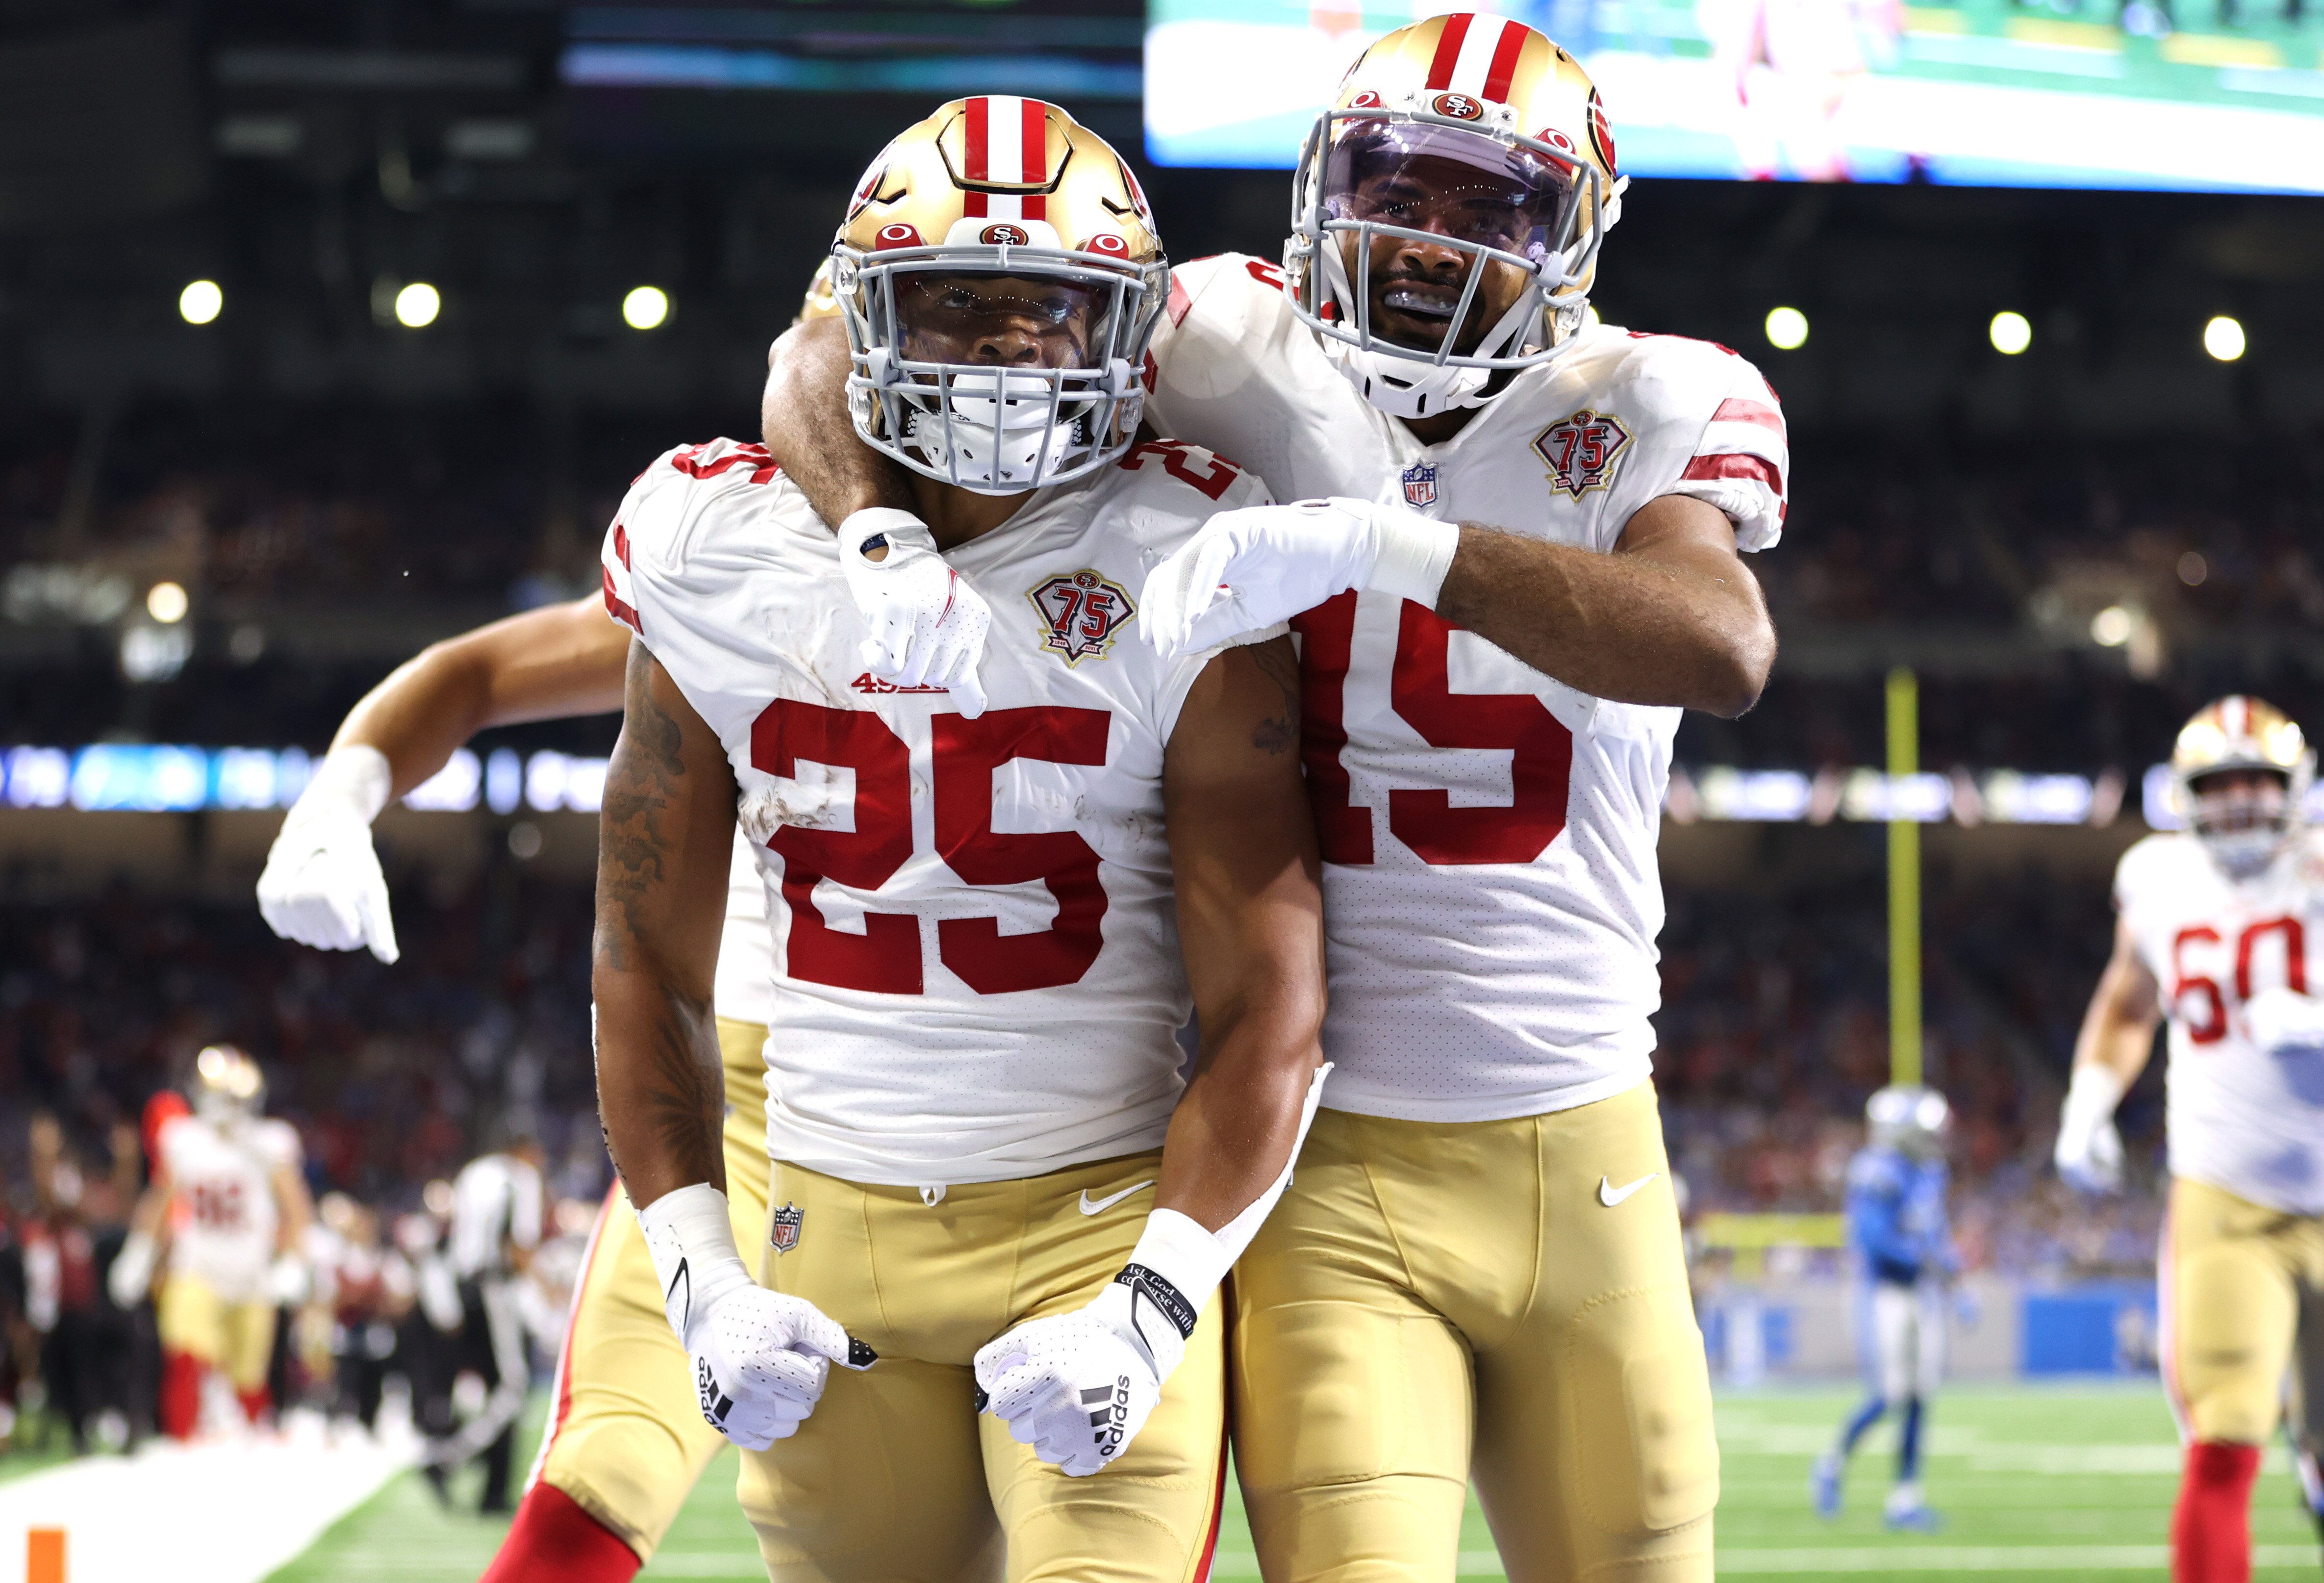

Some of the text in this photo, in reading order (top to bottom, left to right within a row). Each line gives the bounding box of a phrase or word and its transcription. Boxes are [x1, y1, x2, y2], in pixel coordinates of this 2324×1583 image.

[1446, 96, 1473, 116] SF
[1556, 427, 1605, 472] 75
[1406, 483, 1434, 503] NFL
[1053, 587, 1112, 639] 75
[1289, 588, 1573, 865] 15
[751, 698, 1111, 995] 25
[774, 1226, 793, 1245] NFL
[1121, 1276, 1193, 1331] coerse with
[699, 1356, 728, 1434] adidas
[1100, 1375, 1130, 1456] adidas
